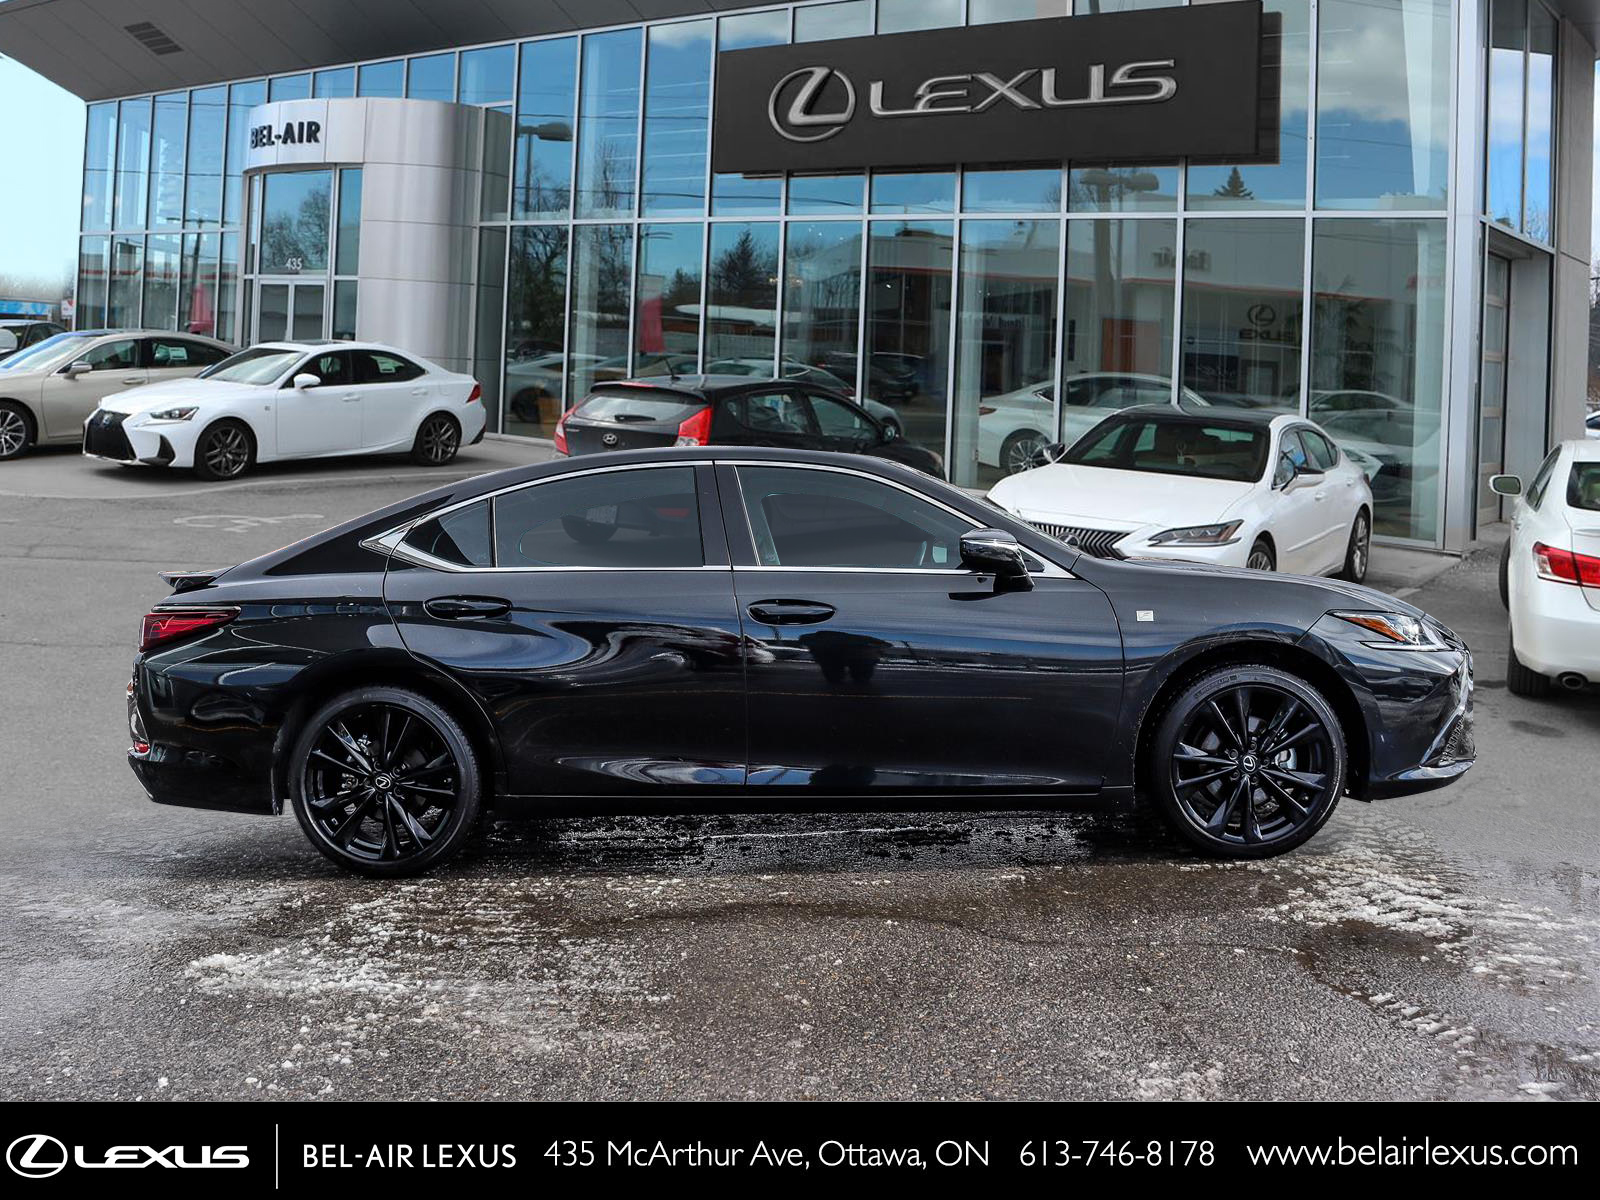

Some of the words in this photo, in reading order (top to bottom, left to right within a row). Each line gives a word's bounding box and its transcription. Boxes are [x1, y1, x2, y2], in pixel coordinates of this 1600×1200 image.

[870, 59, 1177, 117] LEXUS
[250, 120, 321, 149] BEL-AIR
[285, 256, 303, 271] 435
